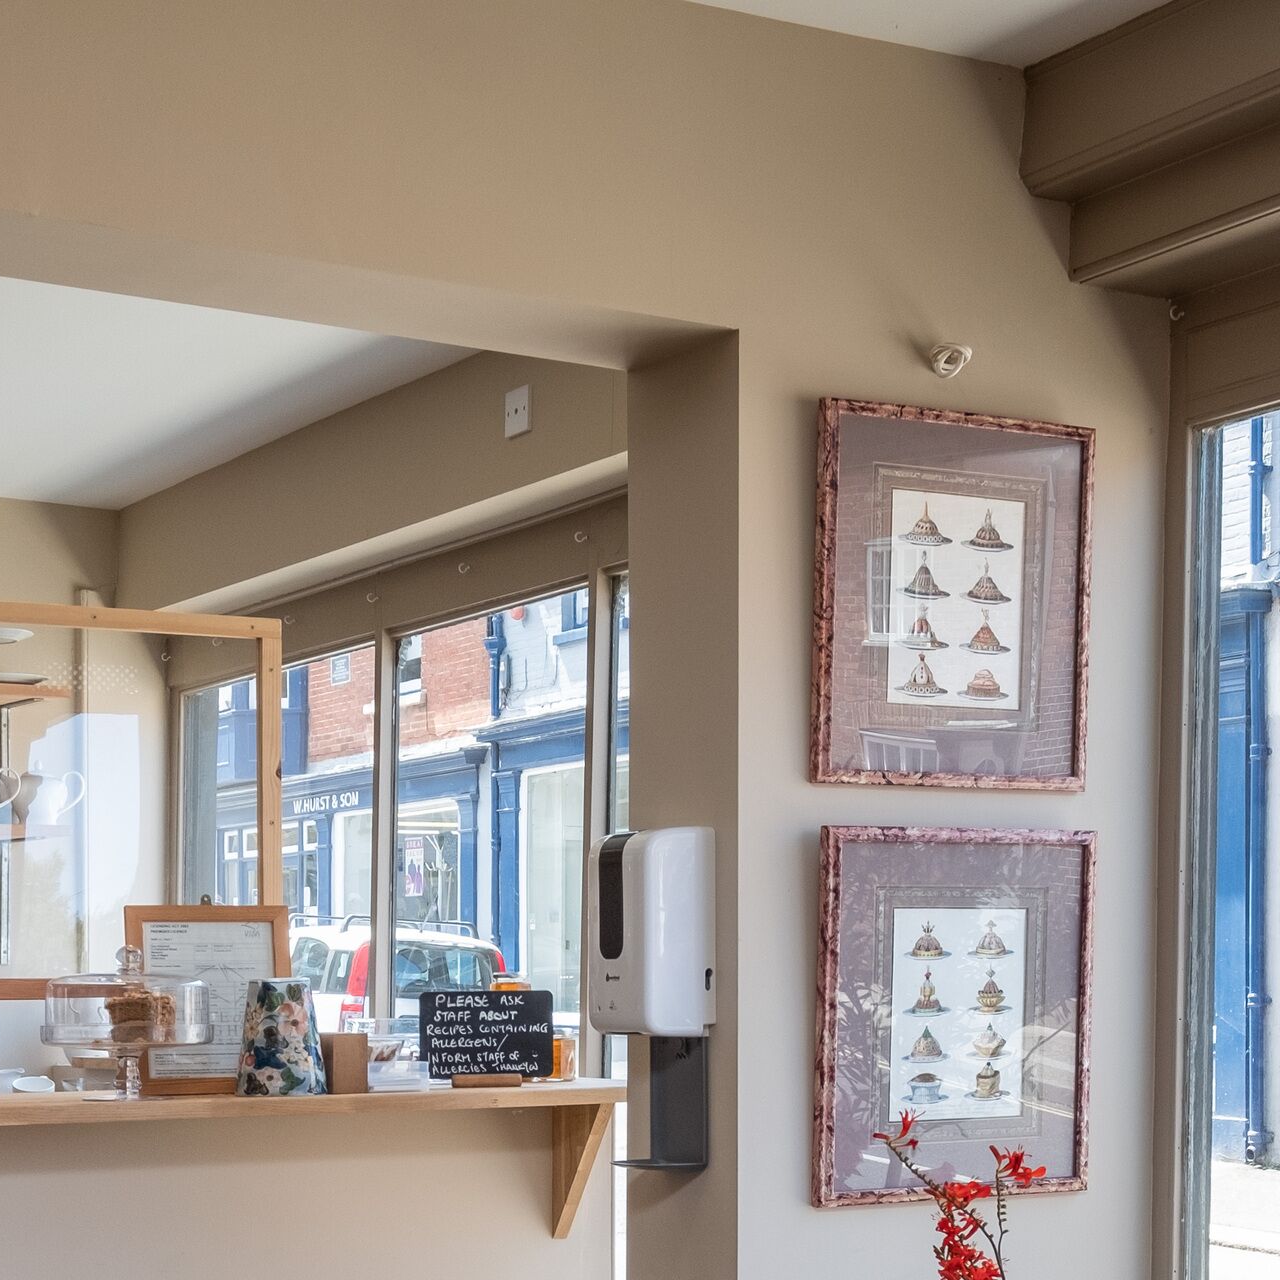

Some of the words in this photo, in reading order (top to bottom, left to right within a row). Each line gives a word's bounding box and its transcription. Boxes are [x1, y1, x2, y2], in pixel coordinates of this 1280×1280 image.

[293, 796, 330, 814] W.HURST
[331, 794, 338, 809] &
[340, 791, 359, 808] SON
[435, 994, 490, 1008] PLEASE
[500, 994, 525, 1006] ASK
[433, 1010, 472, 1022] STAFF
[479, 1010, 518, 1021] ABOUT
[426, 1024, 473, 1036] RECIPES
[479, 1022, 549, 1034] CONTAINING
[428, 1052, 471, 1064] INFORM
[477, 1051, 506, 1063] STAFF
